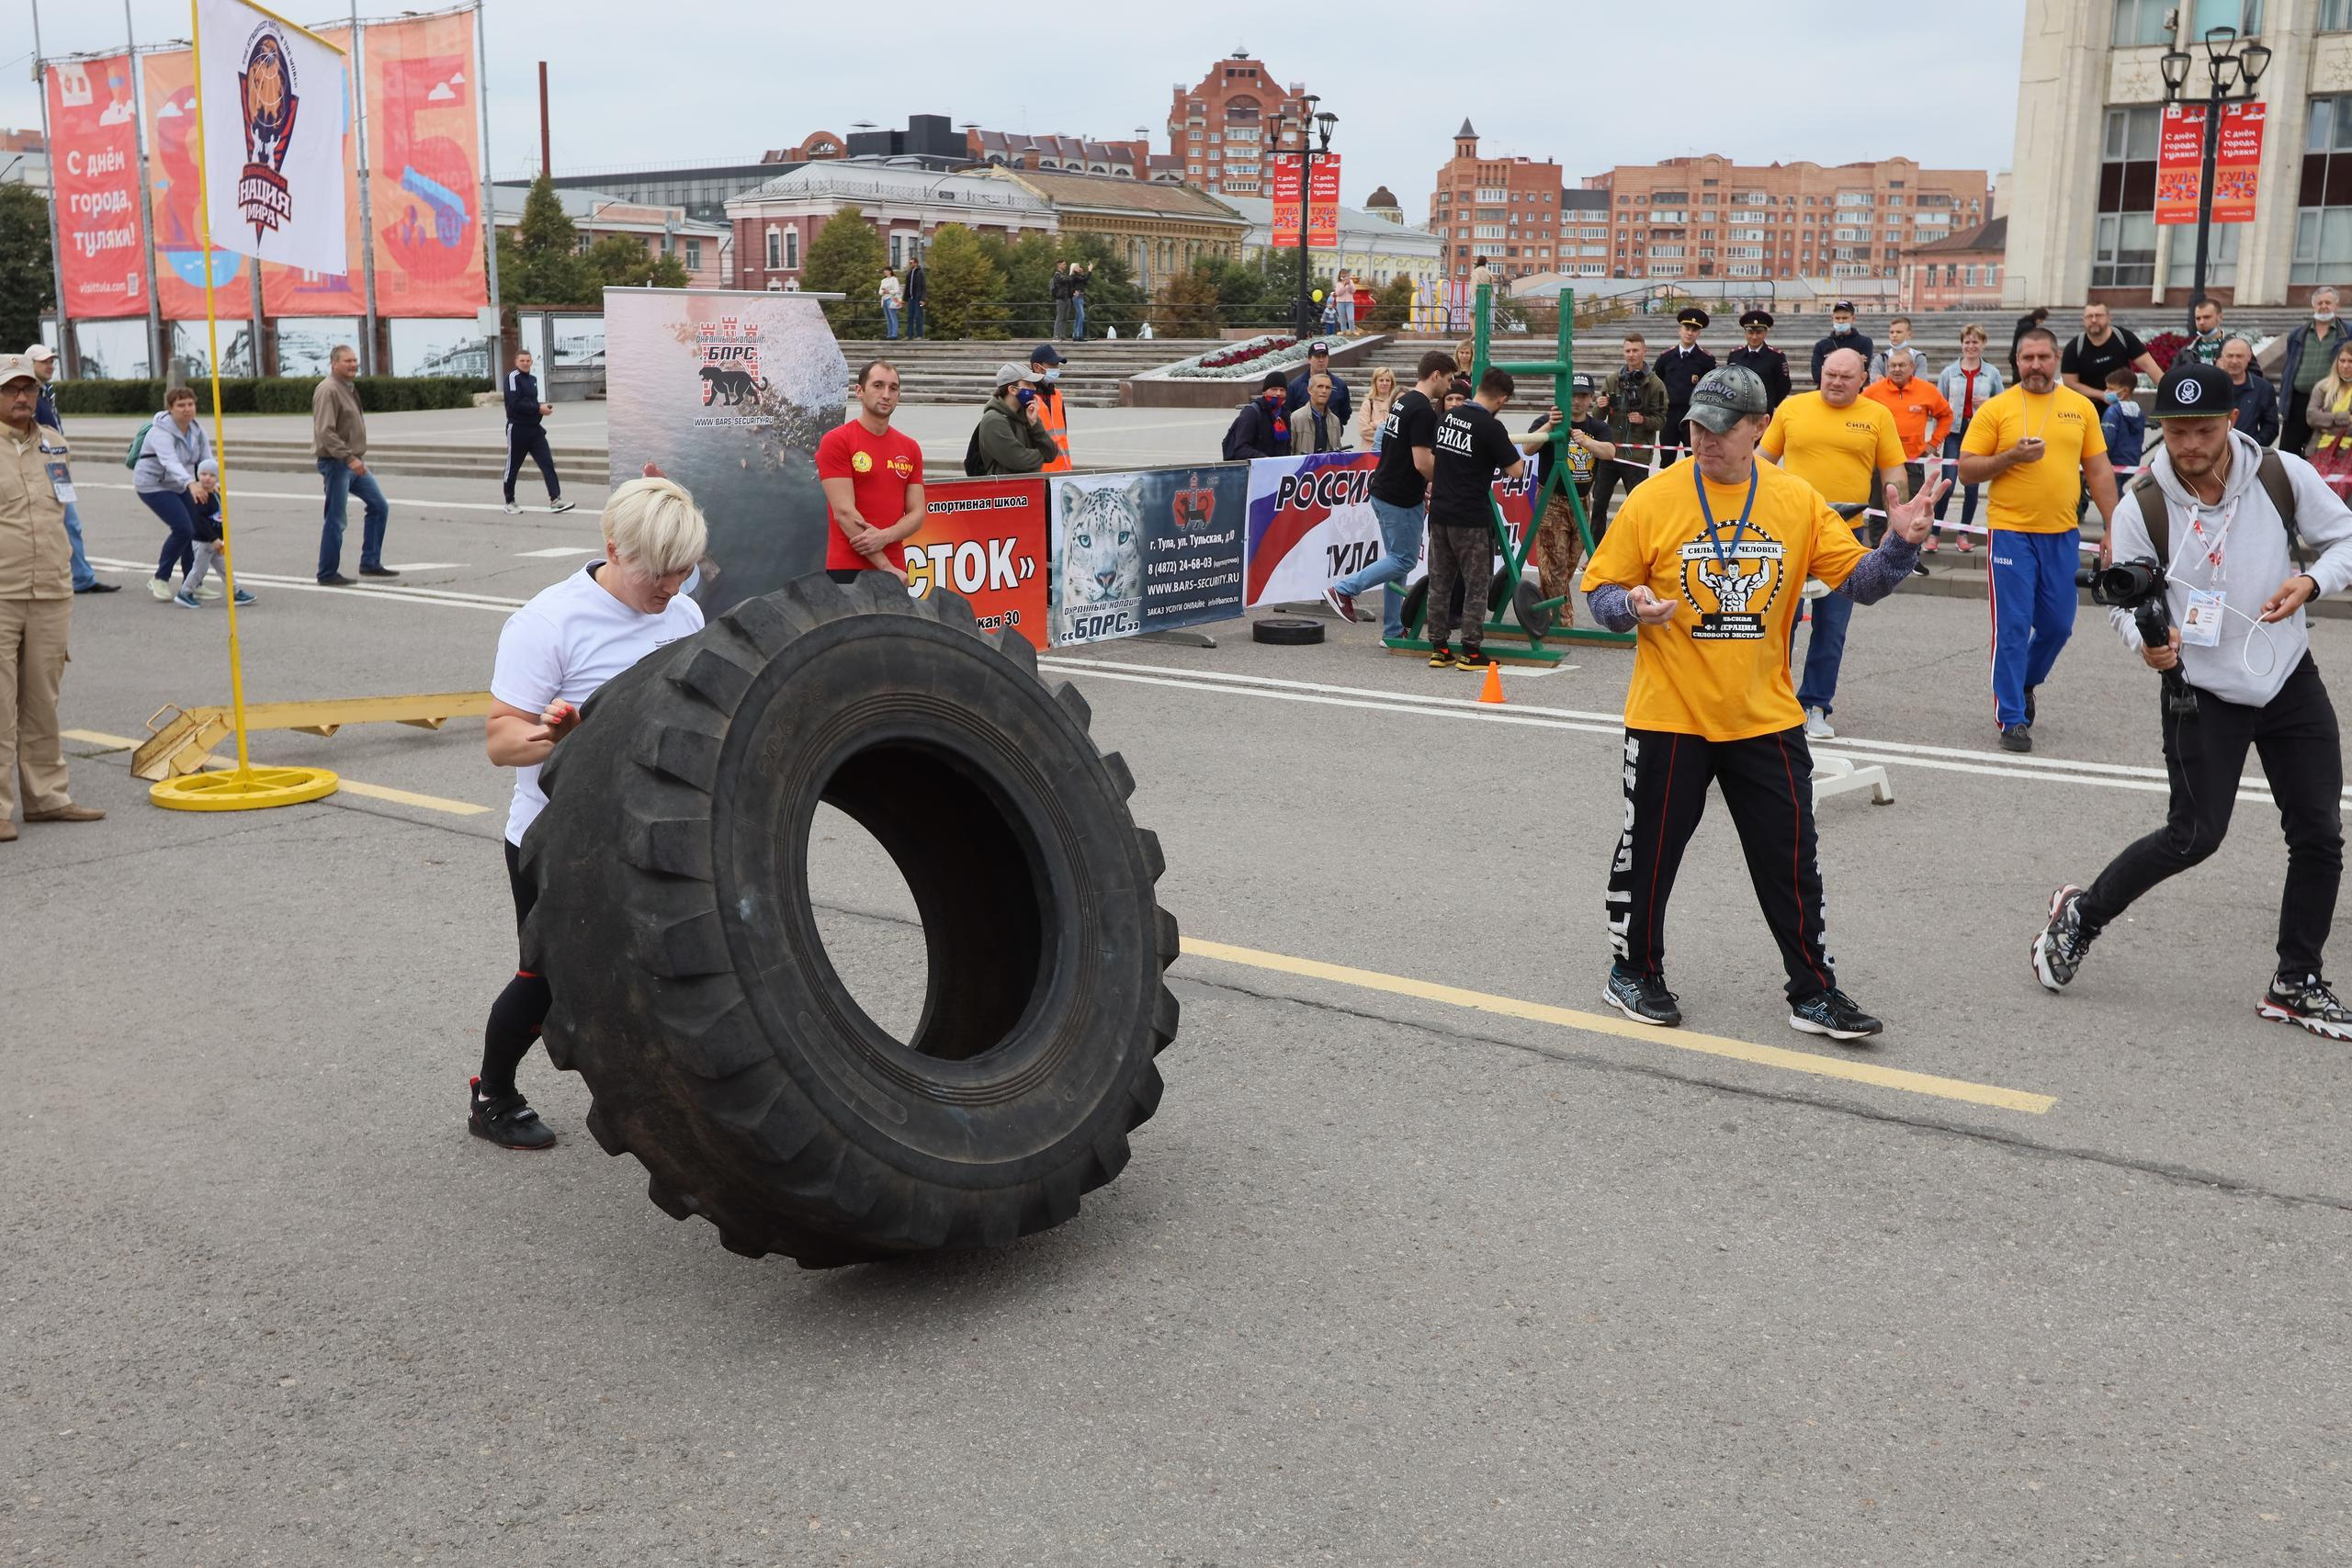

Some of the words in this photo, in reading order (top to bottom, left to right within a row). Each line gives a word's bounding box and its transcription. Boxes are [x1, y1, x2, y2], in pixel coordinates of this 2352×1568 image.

[67, 151, 82, 175] С
[87, 146, 126, 177] днём
[70, 189, 133, 219] города,
[240, 178, 290, 219] НАЦИЯ
[247, 203, 277, 227] МИРА
[74, 222, 136, 258] туляки!
[1846, 422, 1871, 430] СИЛА
[1437, 425, 1473, 452] СИЛА
[928, 499, 991, 514] спортивная
[994, 496, 1028, 509] школа
[1150, 540, 1156, 550] г.
[1158, 537, 1176, 552] Тула,
[1177, 537, 1188, 550] ул.
[1190, 534, 1224, 548] Тульская,
[1738, 546, 1779, 554] ЧЕЛОВЕК
[903, 536, 1036, 599] СТОК»
[1148, 563, 1153, 575] 8
[1155, 560, 1177, 577] (4872)
[1179, 557, 1212, 571] 24-68-03
[1994, 556, 2013, 566] RUSSIA
[1147, 572, 1239, 596] WWW.BARS-SECURITY.RU
[977, 615, 1001, 630] кая
[1004, 610, 1020, 626] 30
[1147, 606, 1164, 616] ЗАКАЗ
